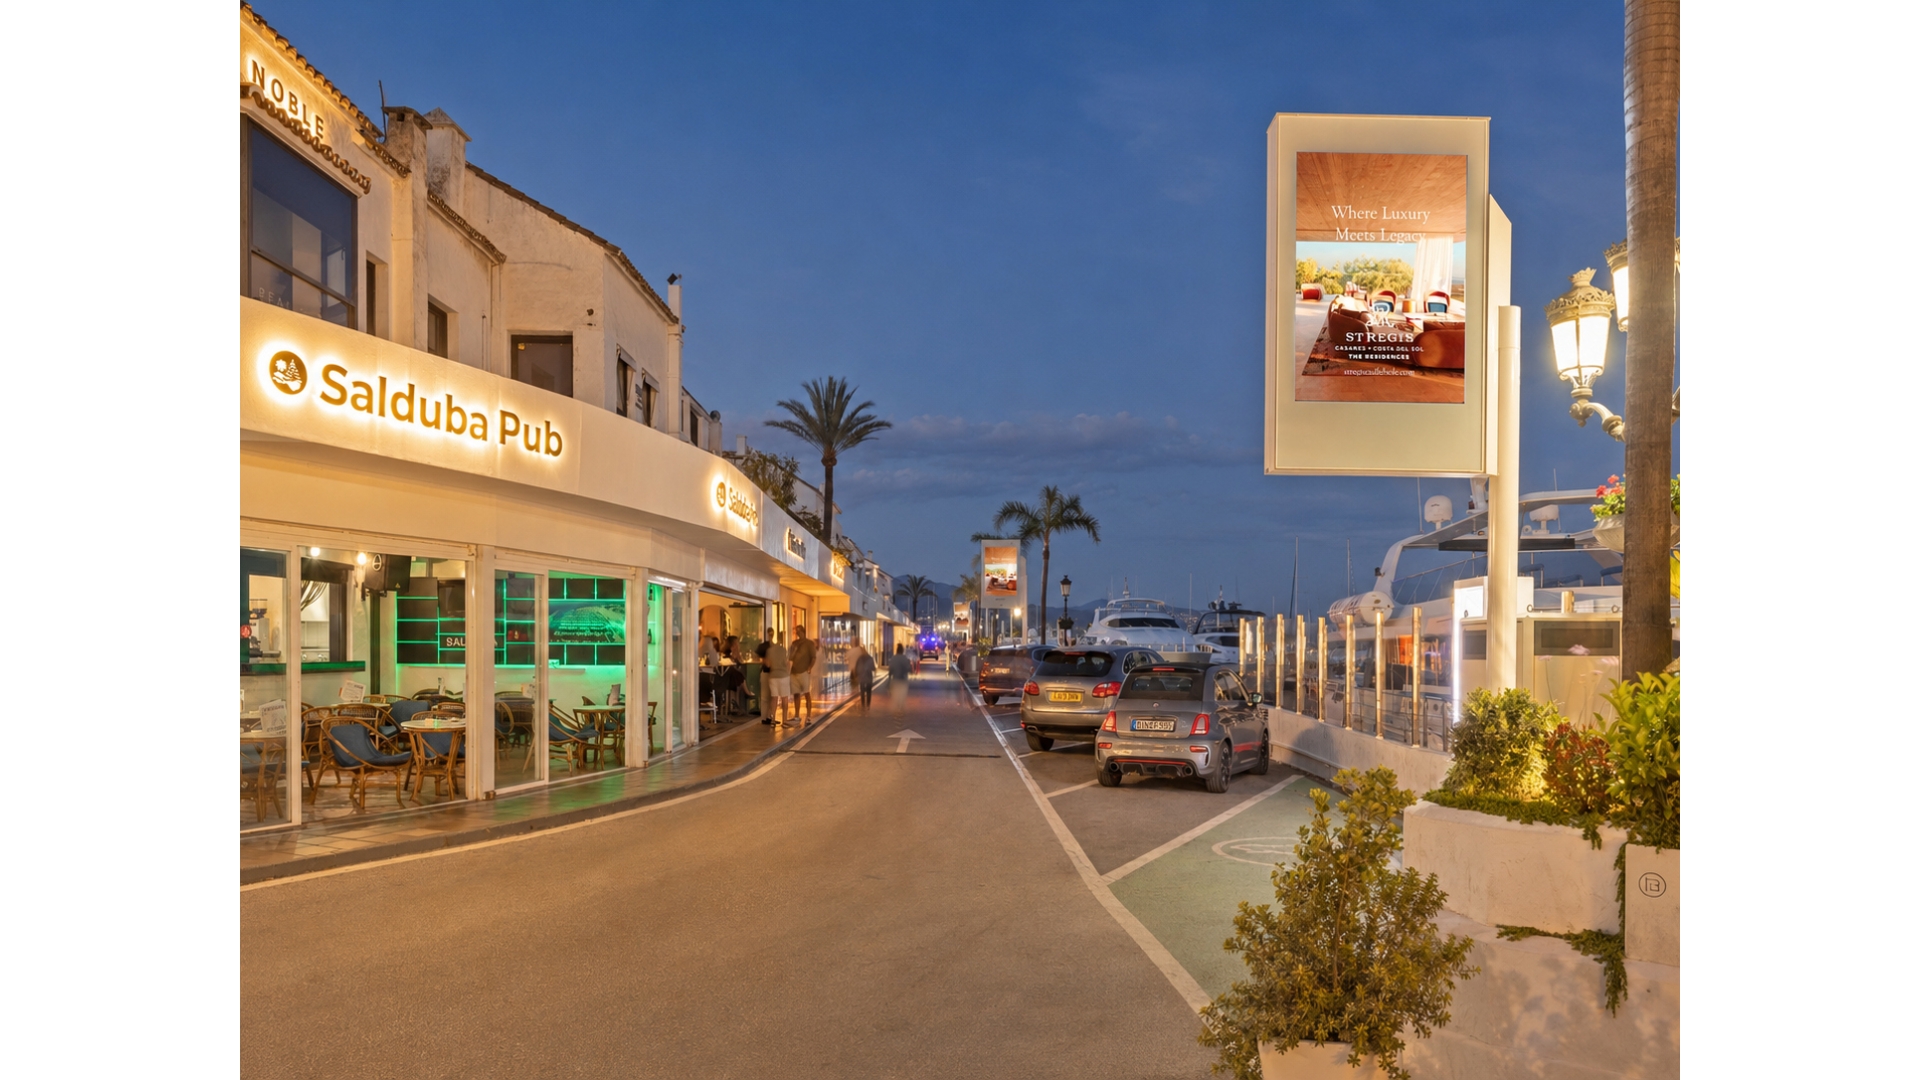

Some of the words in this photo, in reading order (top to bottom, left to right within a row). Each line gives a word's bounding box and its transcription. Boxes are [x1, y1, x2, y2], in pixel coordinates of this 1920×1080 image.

[252, 60, 323, 139] NOBLE
[1331, 205, 1378, 219] Where
[1382, 206, 1430, 225] Luxury
[1335, 227, 1376, 241] Meets
[1380, 228, 1426, 245] Legacy
[1366, 332, 1414, 343] REGIS
[319, 363, 488, 442] Salduba
[499, 409, 563, 457] Pub
